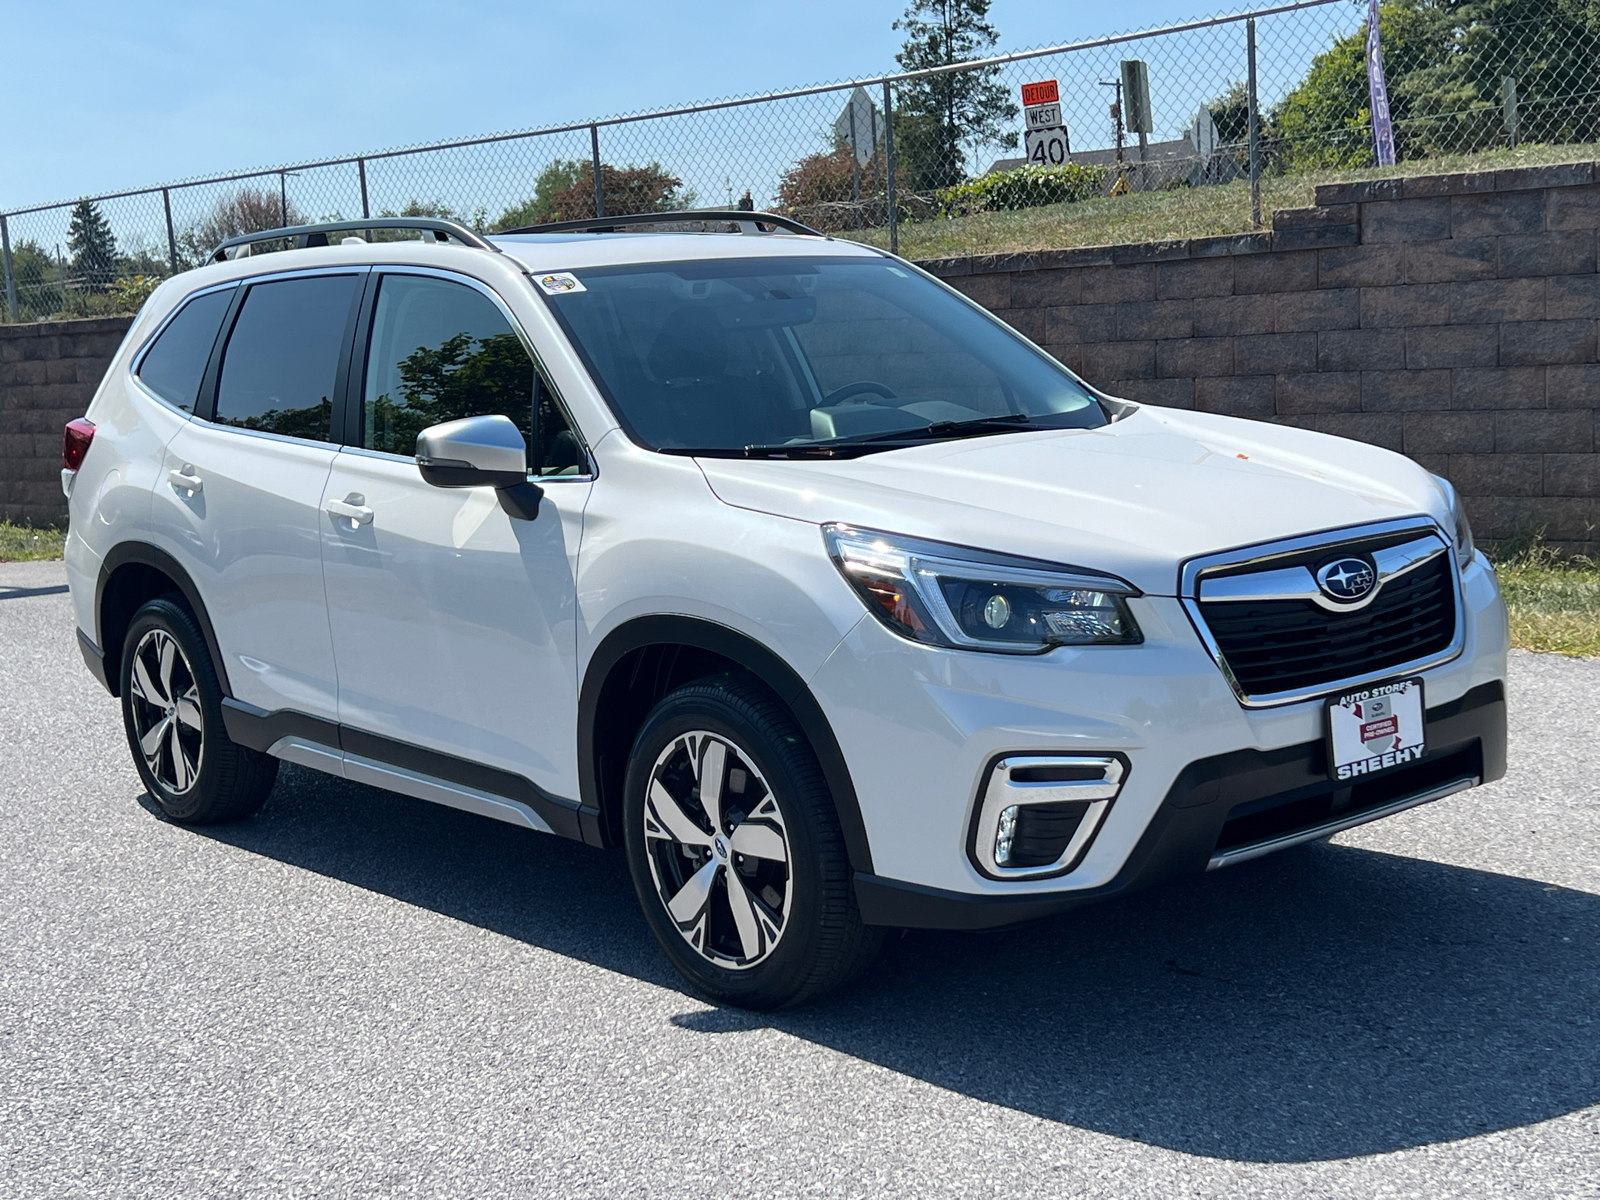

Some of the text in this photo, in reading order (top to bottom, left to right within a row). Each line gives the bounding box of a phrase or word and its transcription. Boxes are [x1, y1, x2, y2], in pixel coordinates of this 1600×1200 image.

[1025, 85, 1055, 101] DETOUR
[1029, 109, 1056, 124] WEST
[1032, 138, 1064, 165] 40
[1340, 680, 1413, 707] AUTO STORES
[1364, 726, 1395, 738] PRE-OWNED
[1366, 720, 1392, 731] CERTIFIED
[1337, 744, 1425, 780] SHEEHY
